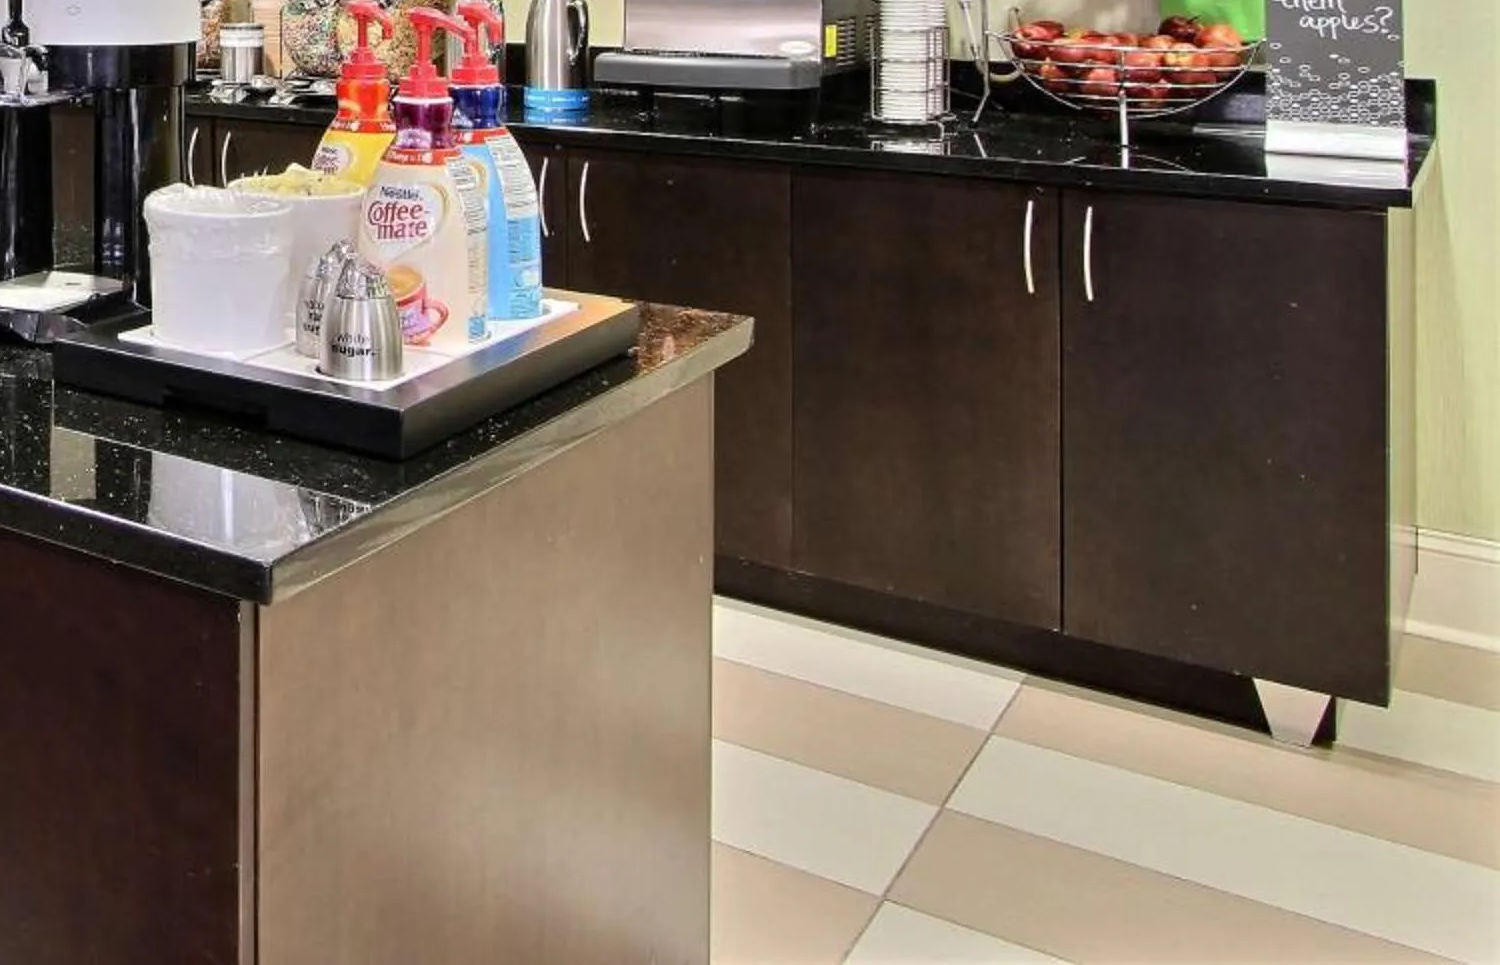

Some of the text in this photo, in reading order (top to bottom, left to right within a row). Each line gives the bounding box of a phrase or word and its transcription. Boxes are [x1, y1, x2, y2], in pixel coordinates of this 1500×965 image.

[1299, 6, 1394, 40] apples?
[376, 220, 428, 240] mate
[331, 344, 377, 358] sugar.
